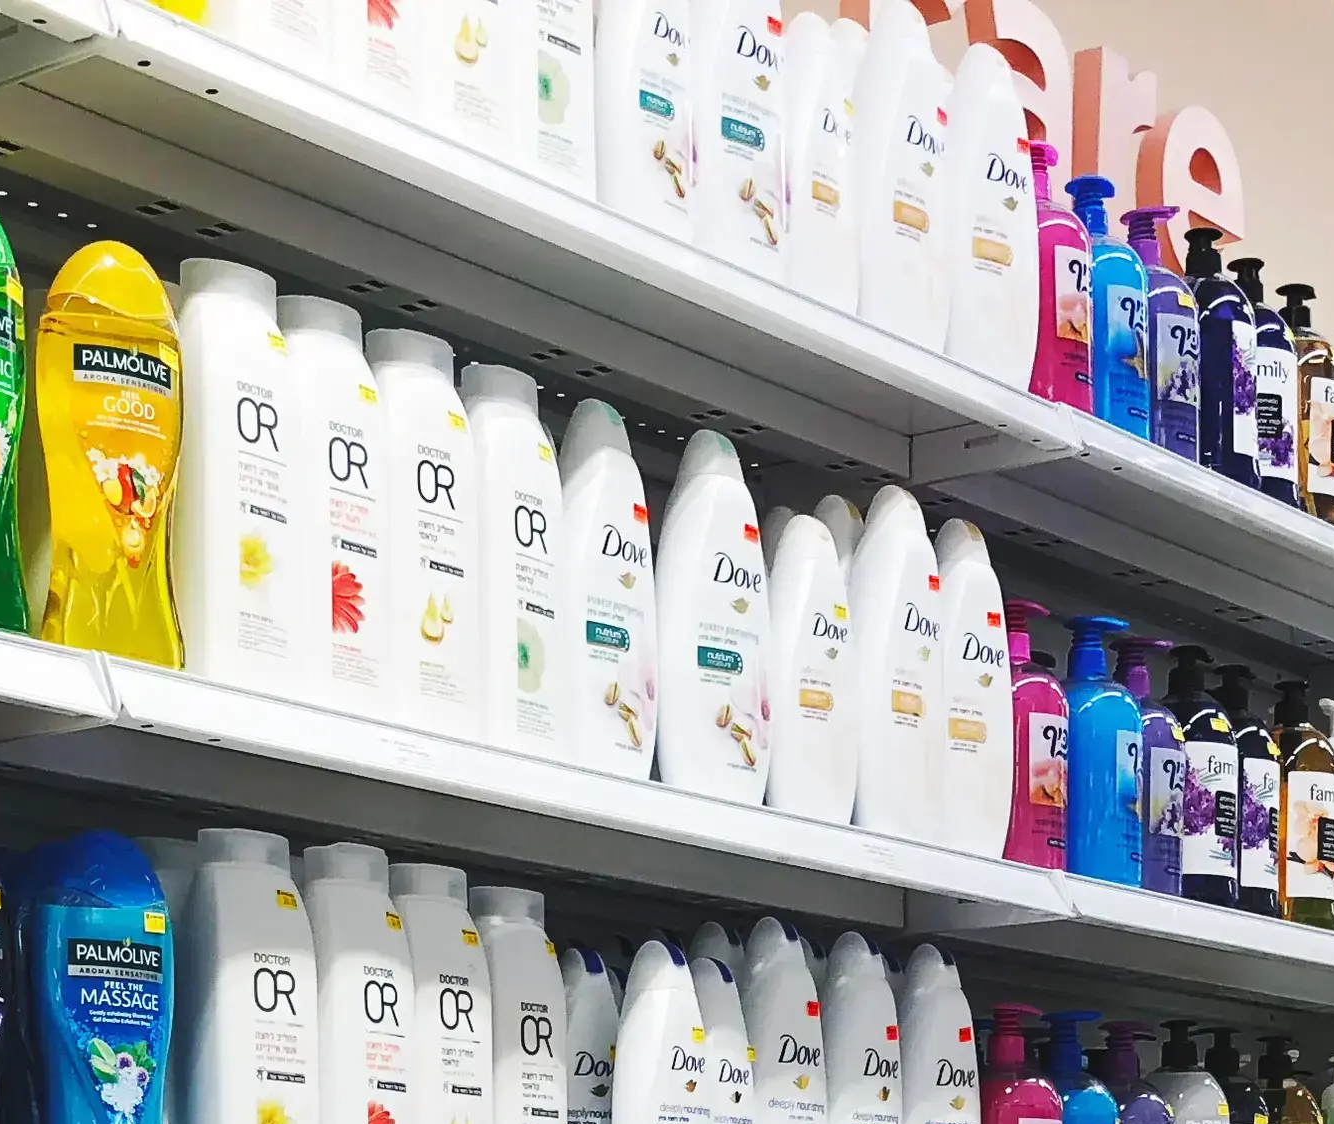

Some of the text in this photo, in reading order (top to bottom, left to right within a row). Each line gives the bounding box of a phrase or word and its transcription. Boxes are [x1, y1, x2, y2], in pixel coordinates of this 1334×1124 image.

[987, 153, 1028, 193] Dove
[82, 350, 168, 382] PALMOLIVE
[84, 373, 116, 384] AROMA
[103, 396, 156, 420] GOOD
[237, 397, 279, 452] OR
[329, 437, 368, 489] OR
[417, 444, 451, 461] DOCTOR
[417, 459, 455, 510] OR
[514, 490, 543, 507] DOCTOR
[514, 505, 547, 554] OR
[602, 525, 647, 567] Dove
[713, 552, 761, 592] Dove
[813, 612, 847, 643] Dove
[905, 602, 940, 641] Dove
[963, 632, 1004, 667] Dove
[76, 944, 160, 967] PALMOLIVE
[254, 953, 291, 966] DOCTOR
[104, 981, 144, 992] FEEL THE
[114, 970, 158, 981] SENSATIONS
[363, 965, 394, 979] DOCTOR
[439, 974, 469, 986] DOCTOR
[81, 988, 159, 1011] MASSAGE
[254, 967, 297, 1016] OR
[364, 980, 399, 1027] OR
[520, 1001, 548, 1013] DOCTOR
[439, 988, 474, 1032] OR
[521, 1015, 553, 1058] OR
[778, 1034, 820, 1067] Dove
[671, 1045, 705, 1073] Dove
[719, 1058, 749, 1085] Dove
[863, 1048, 898, 1079] Dove
[936, 1058, 975, 1087] Dove
